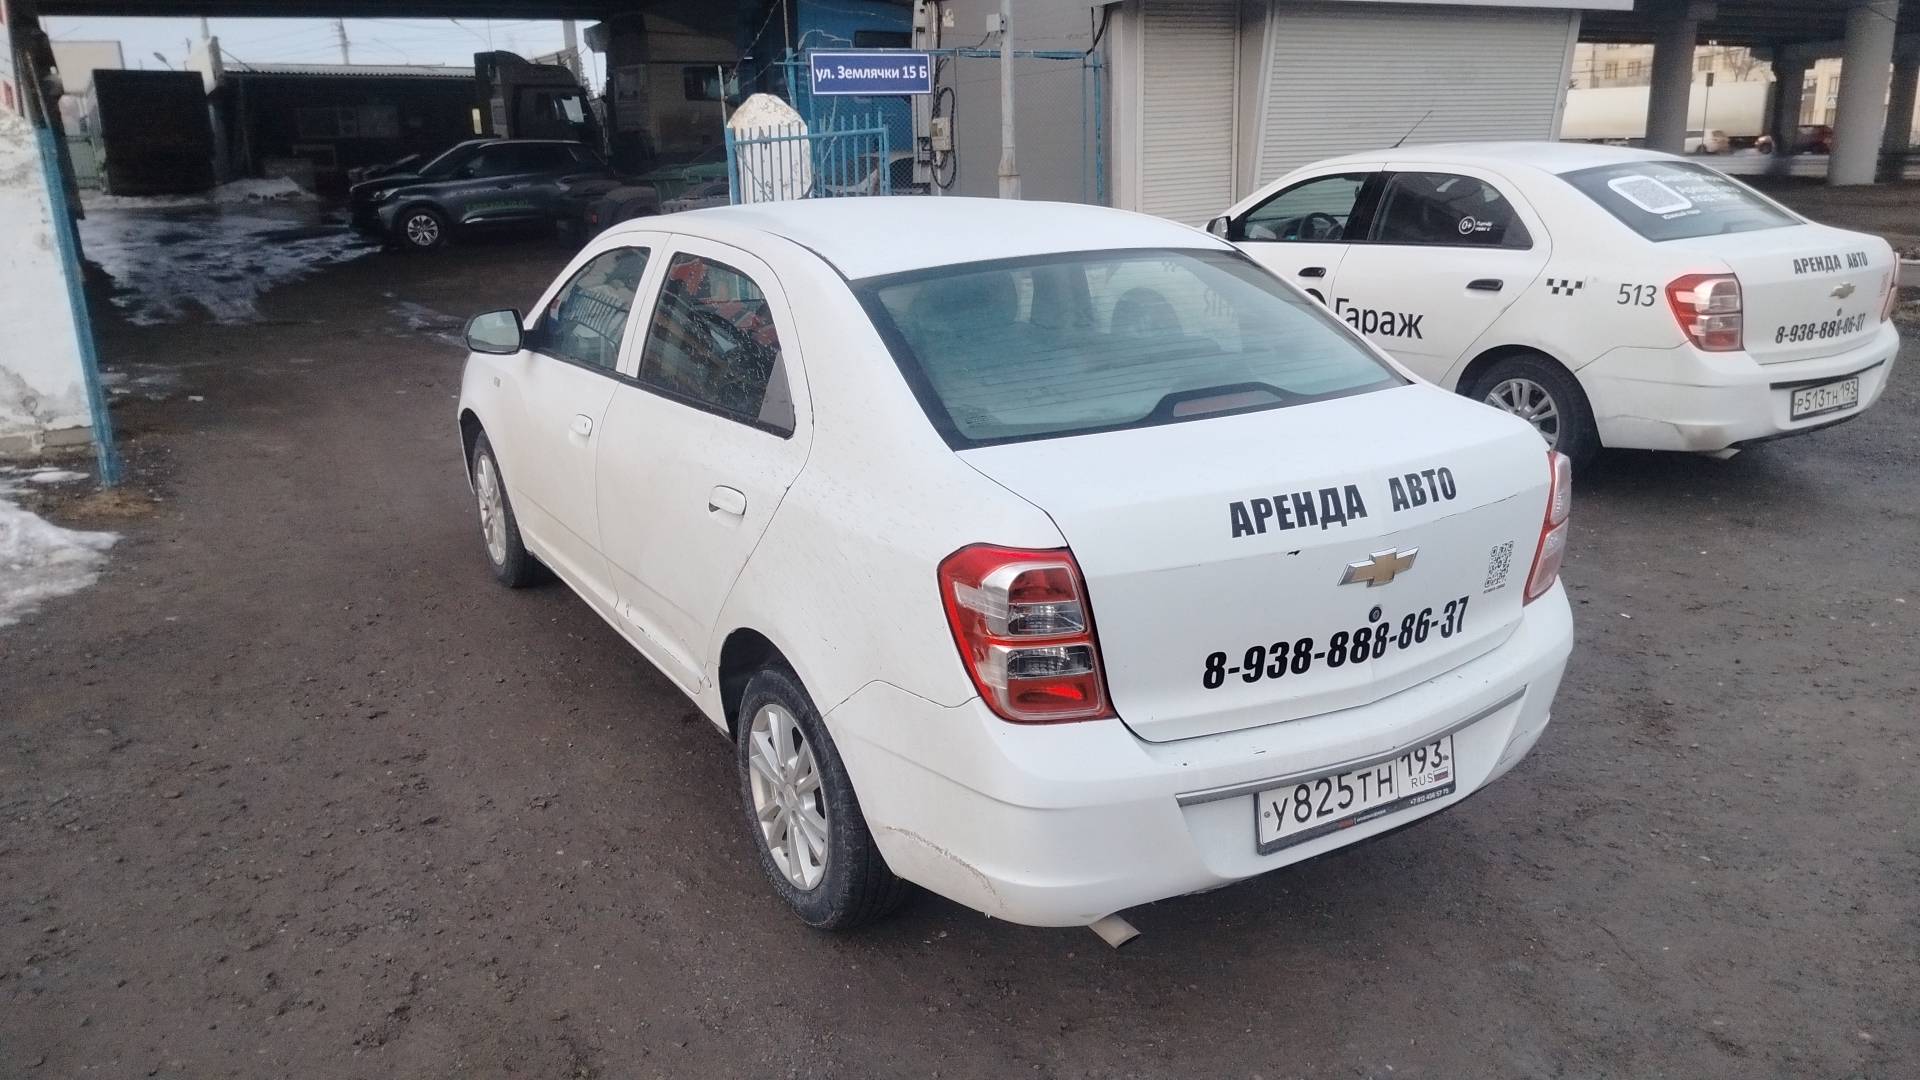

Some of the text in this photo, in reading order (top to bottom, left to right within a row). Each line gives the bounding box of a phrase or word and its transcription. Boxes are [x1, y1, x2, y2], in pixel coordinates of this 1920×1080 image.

[815, 65, 927, 82] ул. Землячки 15 Б
[1793, 251, 1868, 275] АРЕНДА АВТО
[1616, 283, 1657, 307] 513
[1336, 297, 1424, 339] Гараж
[1775, 313, 1866, 344] 8-938-888-86-37
[1229, 467, 1457, 538] АРЕНДА АВТО
[1203, 595, 1470, 690] 8-938-888-86-37
[1400, 742, 1443, 778] 193
[1411, 773, 1434, 789] RUS
